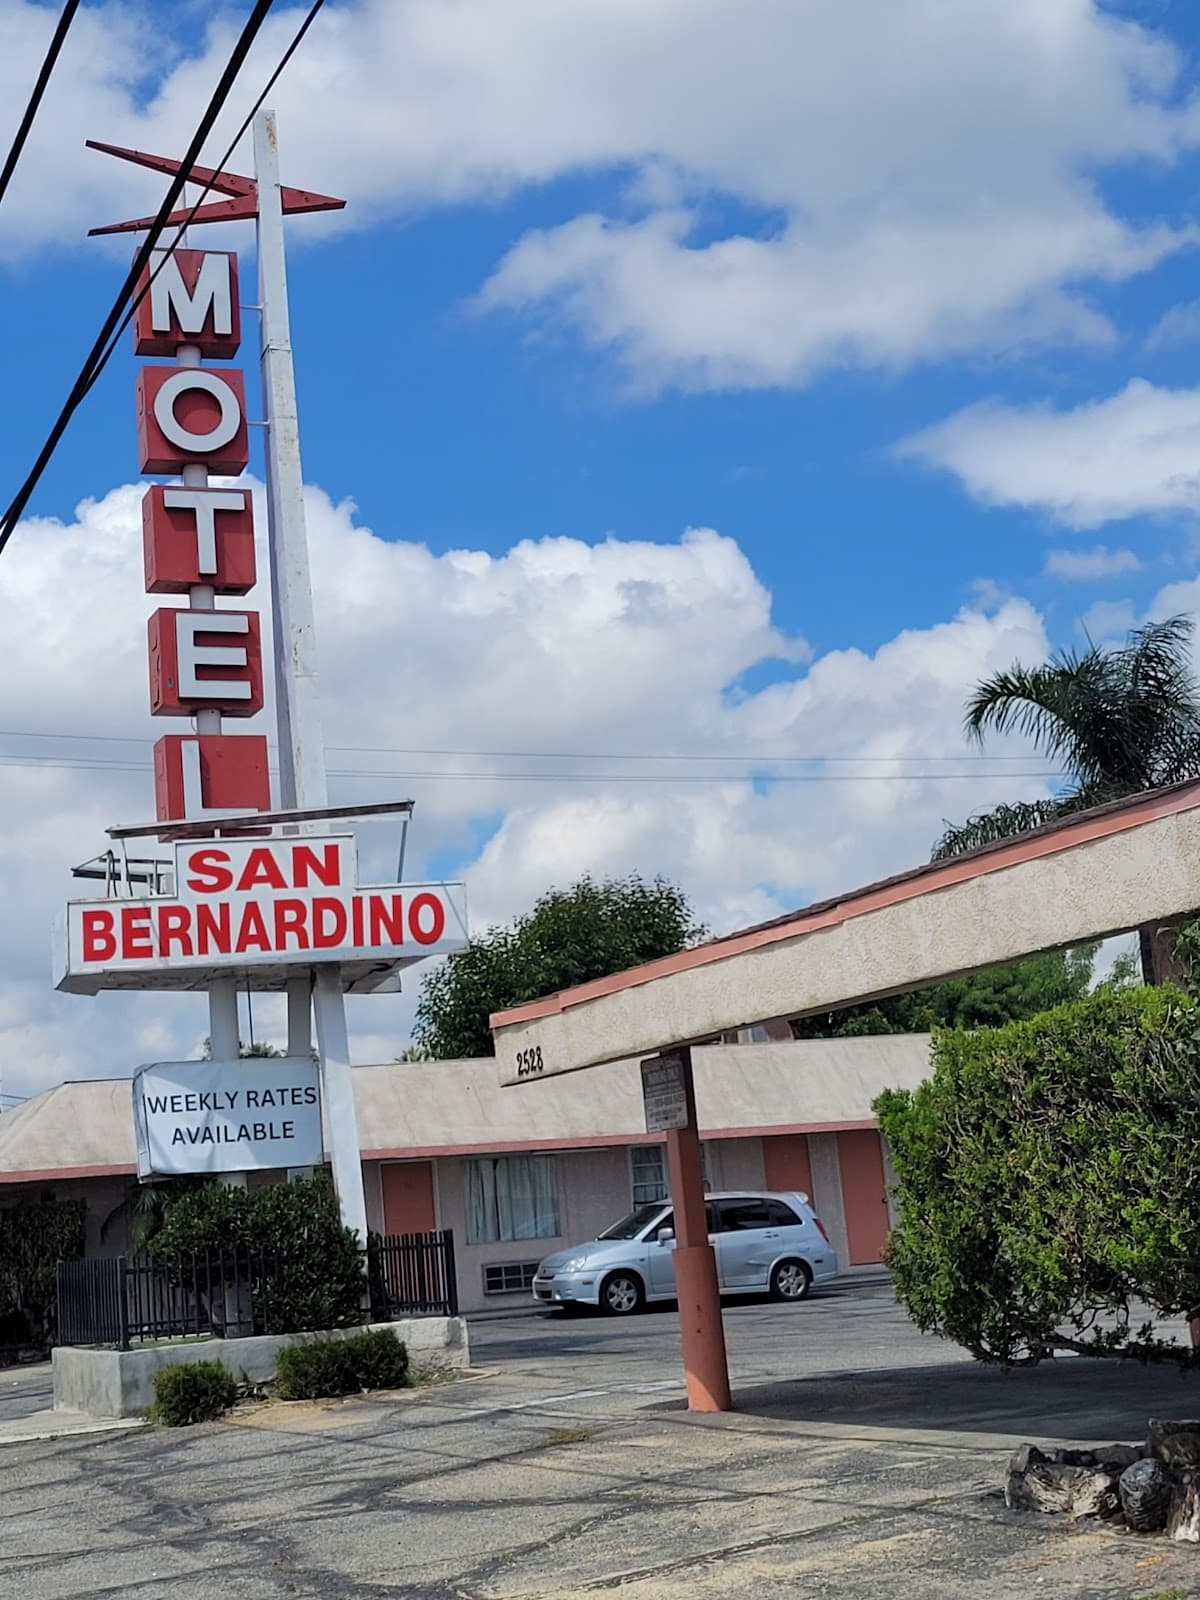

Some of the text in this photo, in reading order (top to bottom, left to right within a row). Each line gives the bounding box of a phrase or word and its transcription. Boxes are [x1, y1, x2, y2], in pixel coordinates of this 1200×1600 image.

[149, 250, 259, 821] MOTEL
[186, 844, 341, 894] SAN
[82, 892, 445, 962] BERNARDINO
[516, 1045, 543, 1077] 2528
[147, 1086, 317, 1114] WEEKLY RATES
[172, 1120, 295, 1146] AVAILABLE
